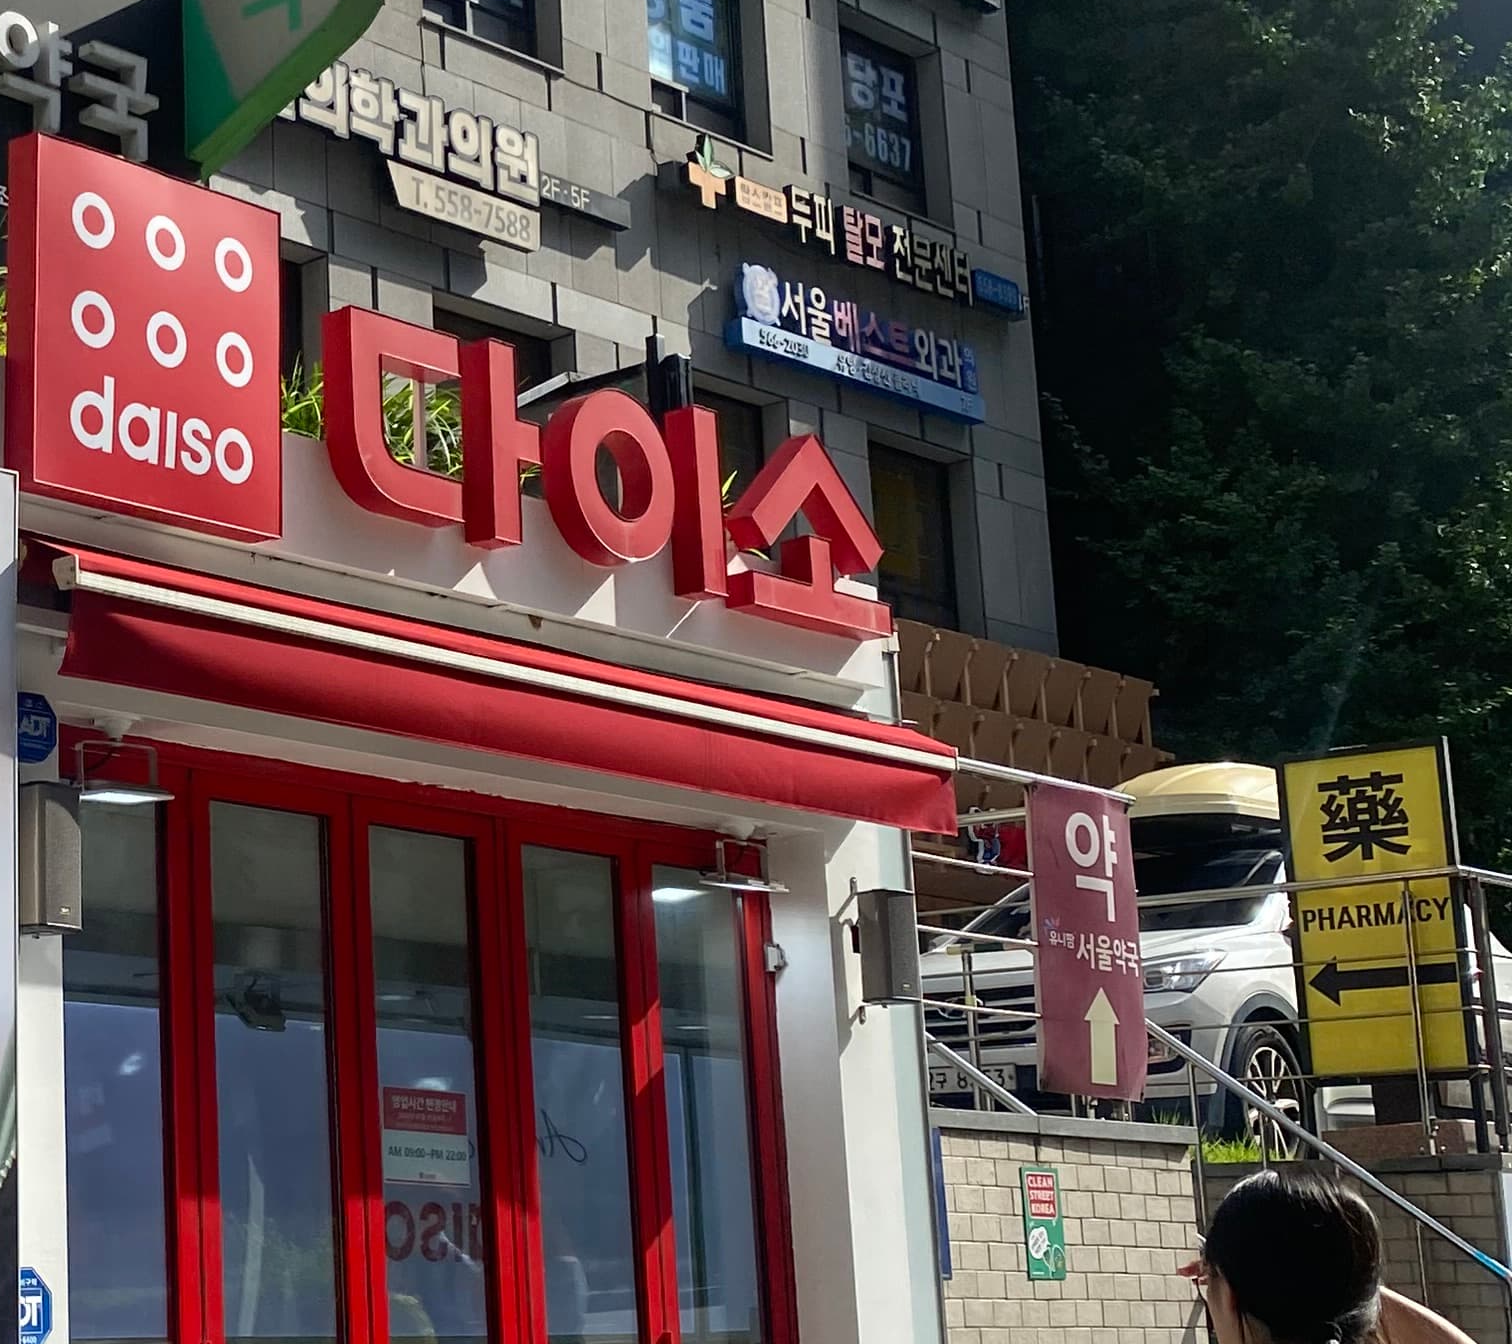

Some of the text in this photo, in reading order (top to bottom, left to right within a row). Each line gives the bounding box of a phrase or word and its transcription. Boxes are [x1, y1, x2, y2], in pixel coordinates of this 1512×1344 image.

[791, 185, 836, 255] 두피
[842, 205, 886, 271] 탈모
[891, 224, 973, 307] 전문센터
[781, 281, 963, 389] 서울베스트외과
[68, 377, 255, 486] daiso
[322, 304, 894, 638] 다이소
[1317, 769, 1412, 862] 藥
[1065, 811, 1118, 923] 약
[1048, 929, 1141, 979] 유니팜 서울약국
[1301, 896, 1452, 934] PHARMACY
[1027, 1175, 1054, 1187] CLEAN
[1029, 1189, 1055, 1201] STREET
[1030, 1202, 1056, 1215] KOREA
